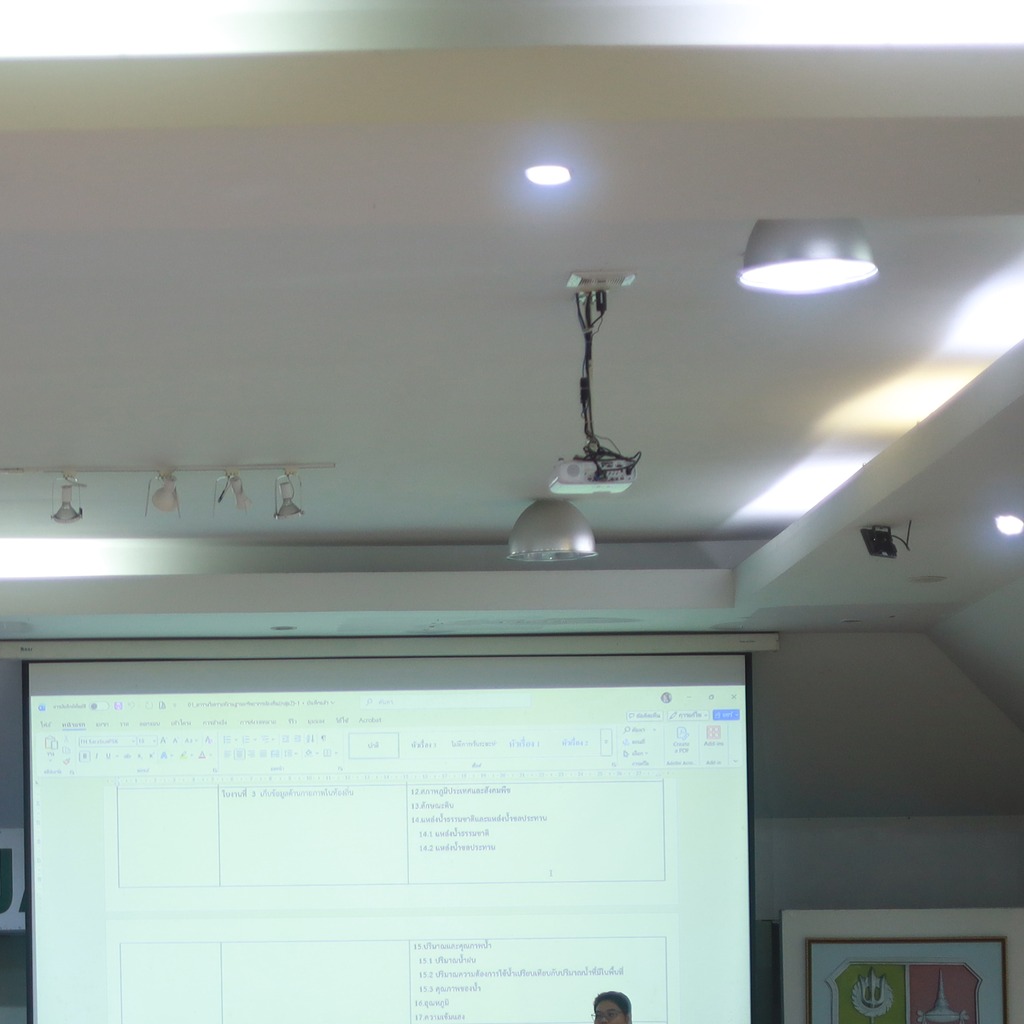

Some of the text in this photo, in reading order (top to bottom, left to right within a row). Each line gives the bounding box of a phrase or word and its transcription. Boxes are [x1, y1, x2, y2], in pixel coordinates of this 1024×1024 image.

[418, 957, 433, 965] 15.1
[419, 971, 434, 979] 15.2
[419, 985, 434, 993] 15.3
